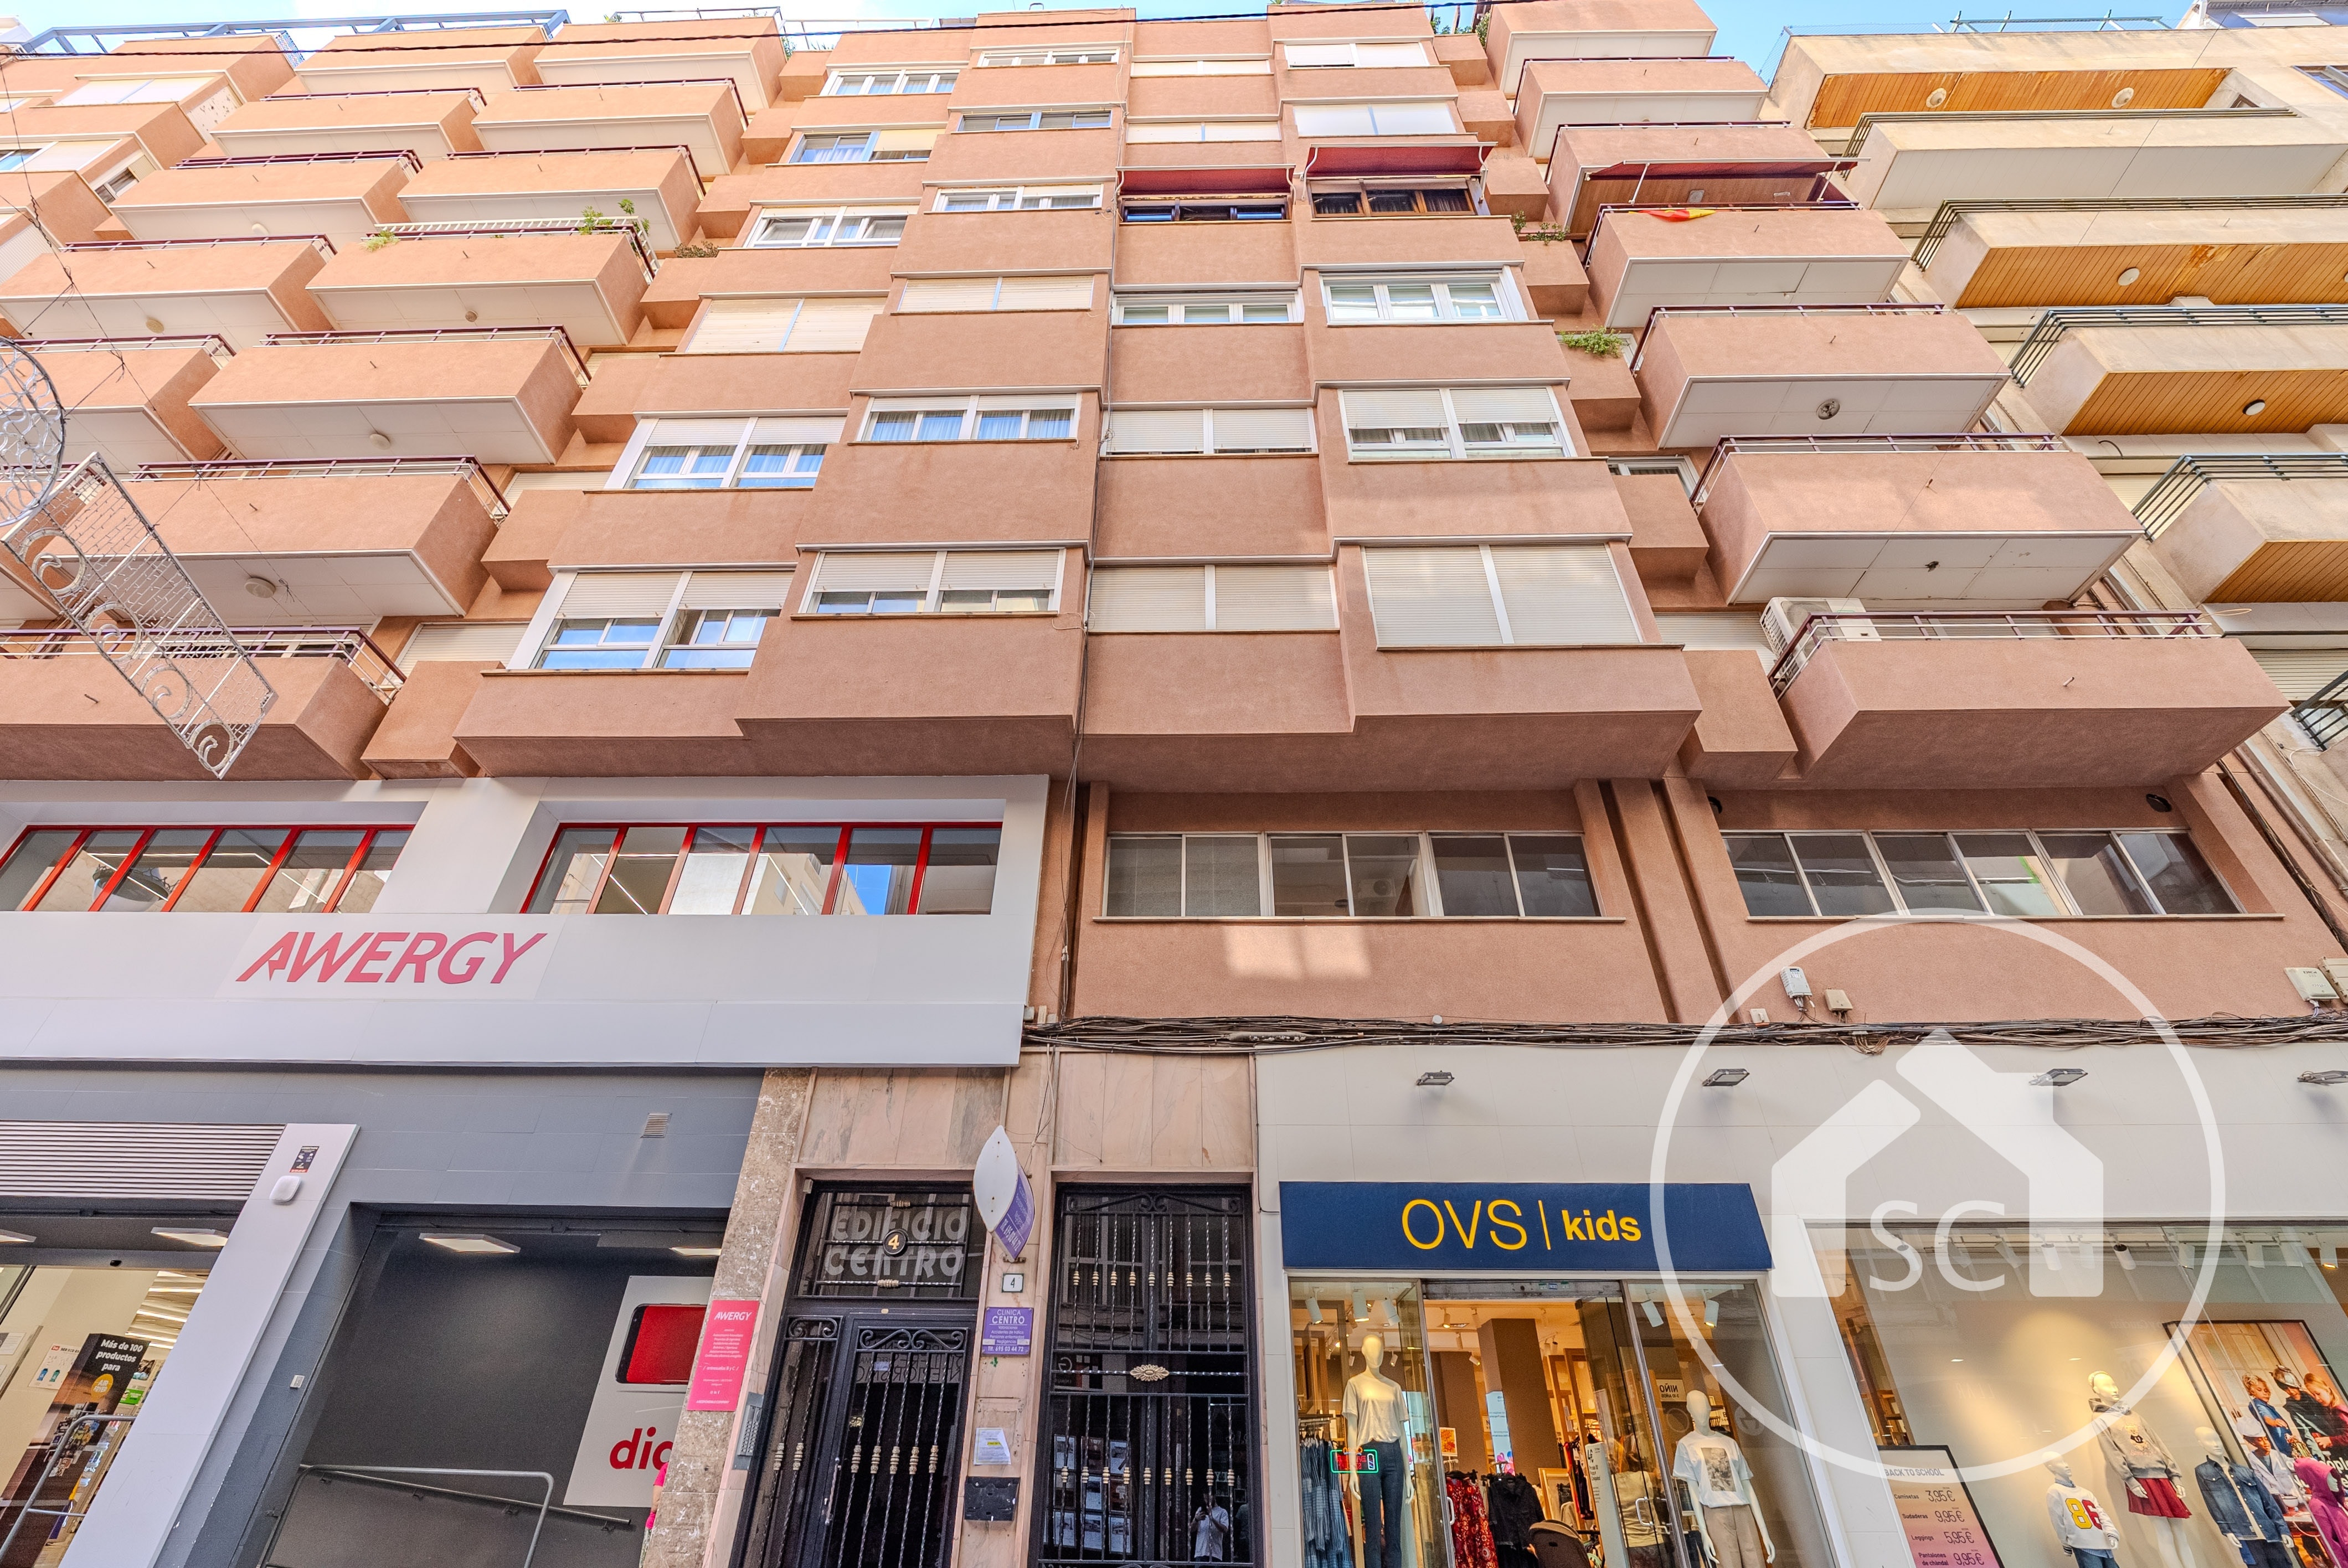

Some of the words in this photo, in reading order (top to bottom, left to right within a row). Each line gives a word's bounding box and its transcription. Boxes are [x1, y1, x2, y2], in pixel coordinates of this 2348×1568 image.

[235, 932, 548, 984] AWERGY
[831, 1210, 968, 1241] EDIFICIO
[1402, 1199, 1527, 1250] OVS
[1562, 1209, 1641, 1241] kids
[887, 1234, 900, 1250] 4
[825, 1245, 963, 1278] CENTRO
[1011, 1277, 1015, 1288] 4
[714, 1312, 752, 1321] AWERGY
[992, 1316, 1025, 1324] CENTRO
[101, 1339, 118, 1349] Más
[118, 1342, 129, 1350] de
[130, 1344, 143, 1352] 100
[95, 1351, 137, 1363] productos
[101, 1363, 121, 1371] para
[1884, 1468, 1904, 1477] BACK
[1925, 1490, 1955, 1503] 3,95€
[1934, 1510, 1965, 1523] 9,95€
[2065, 1498, 2103, 1530] 86
[1944, 1531, 1975, 1544] 5,95€
[1953, 1552, 1985, 1566] 9,95€
